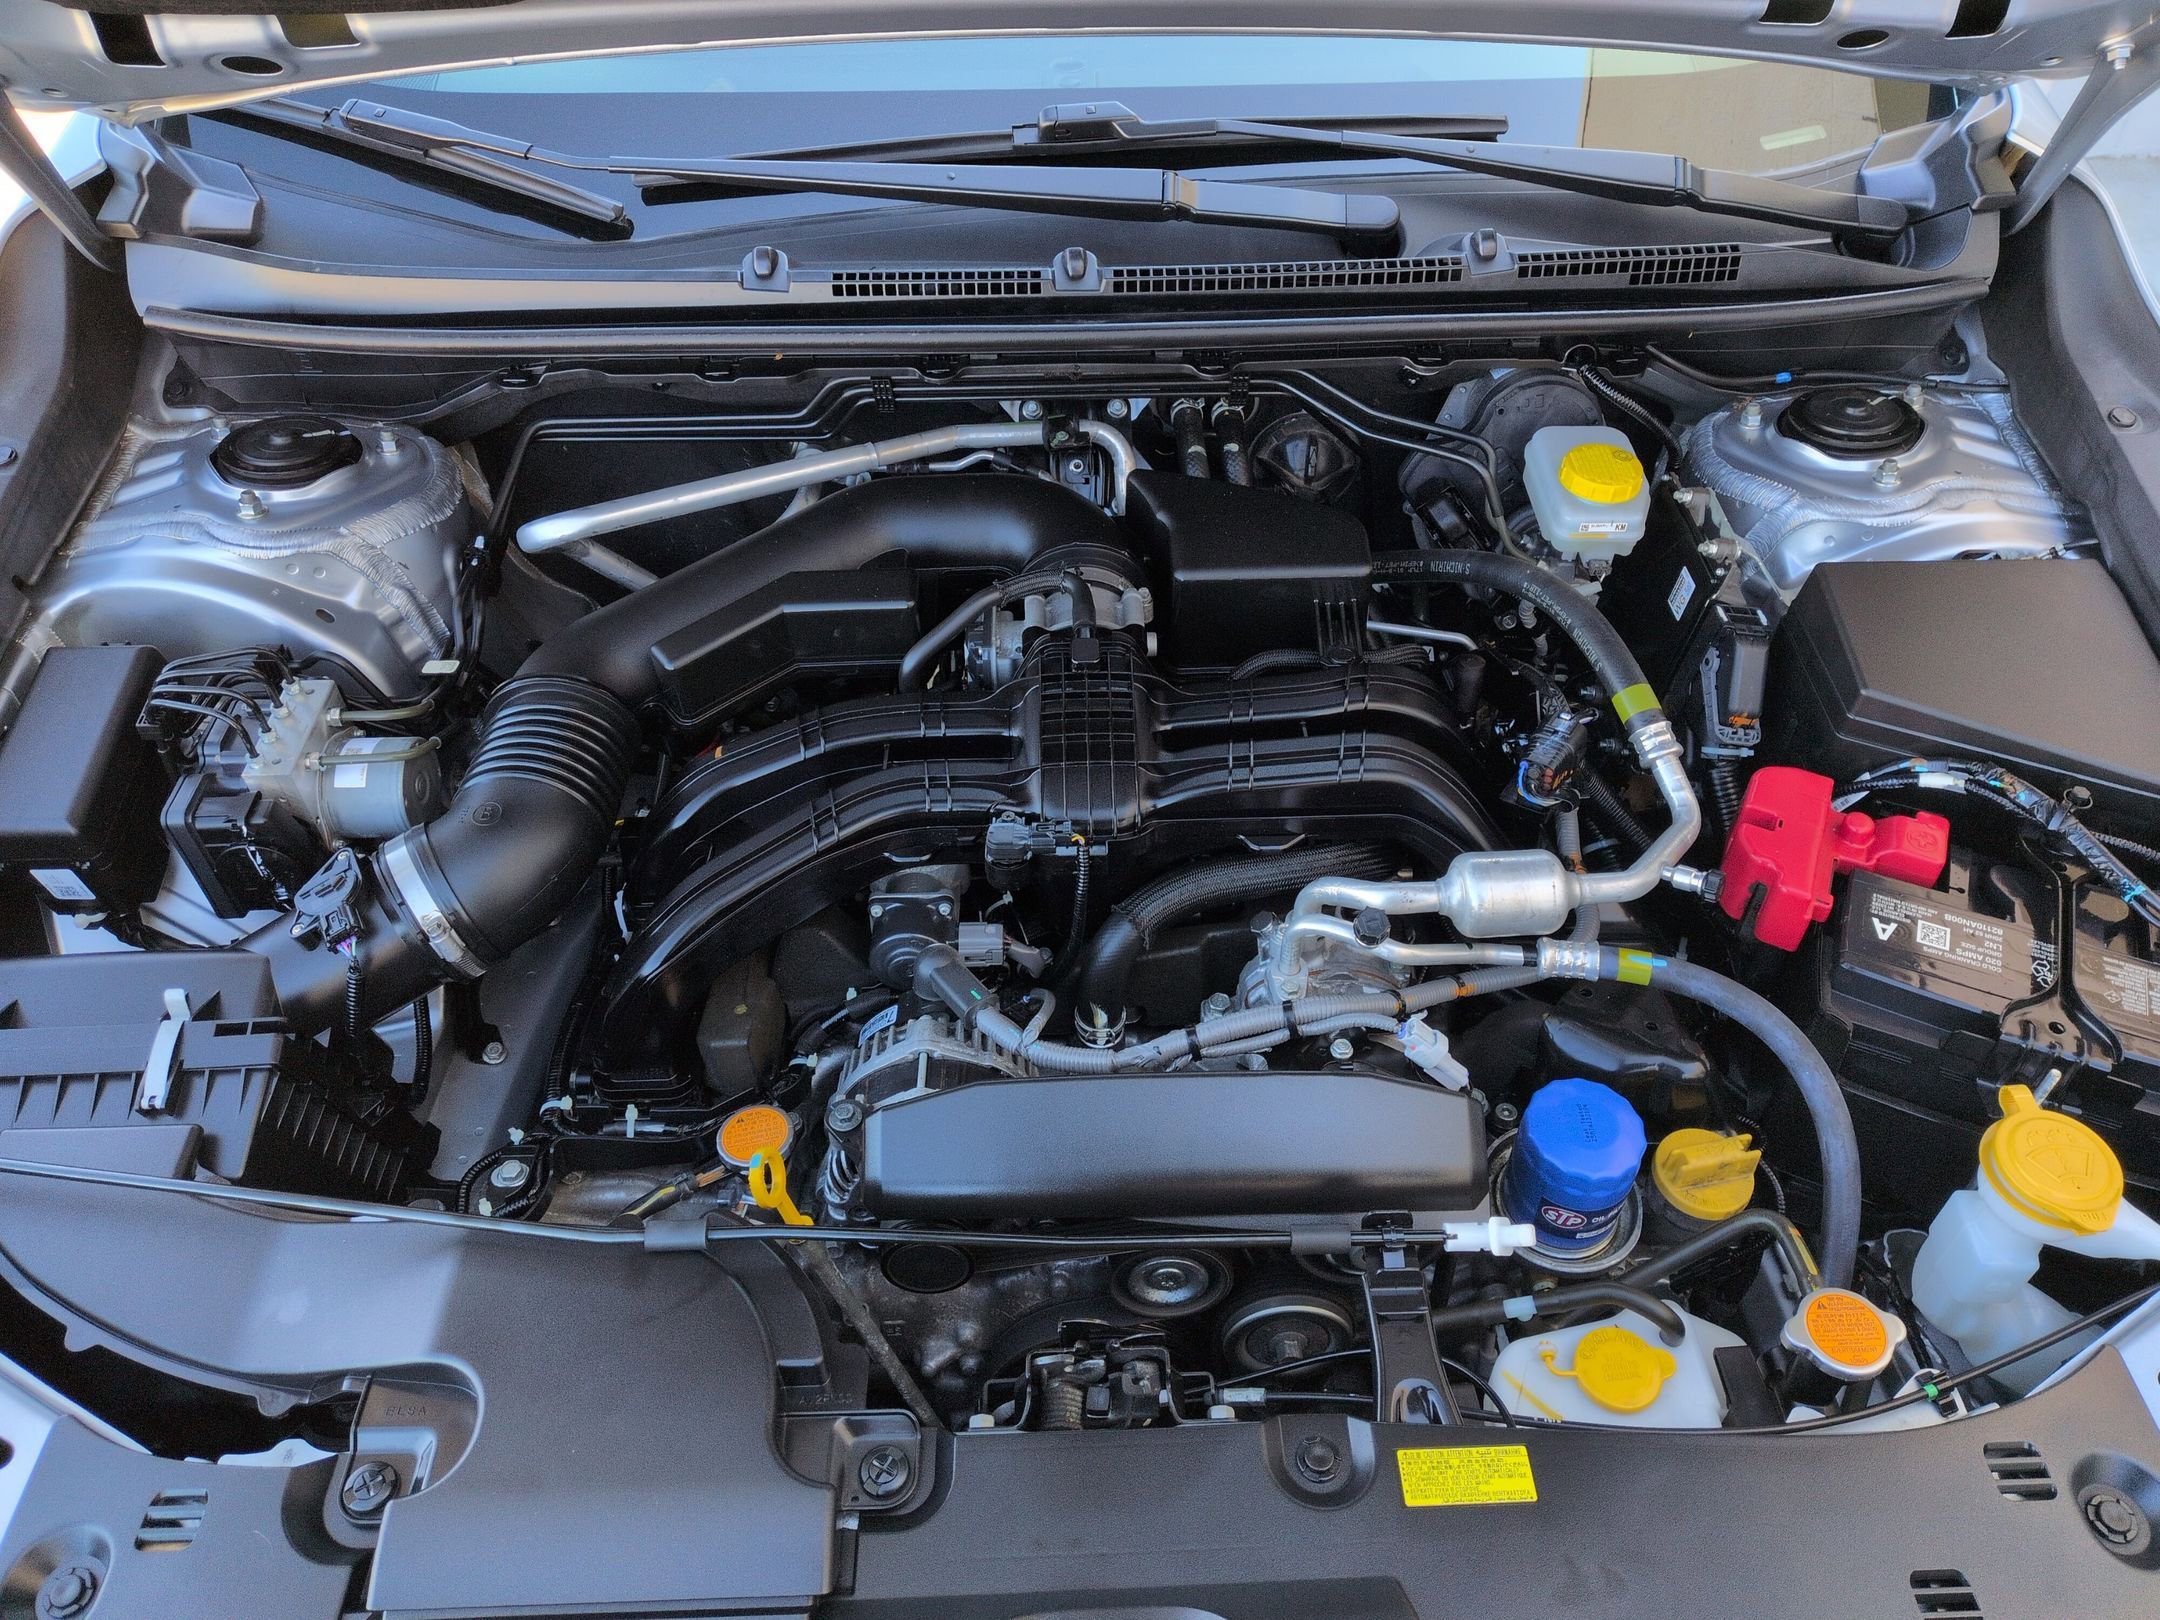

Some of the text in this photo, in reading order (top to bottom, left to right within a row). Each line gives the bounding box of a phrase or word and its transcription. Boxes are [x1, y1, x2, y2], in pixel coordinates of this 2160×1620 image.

[1984, 940, 2003, 952] LN2
[1955, 948, 1984, 961] AMPS
[1545, 1209, 1583, 1226] STP
